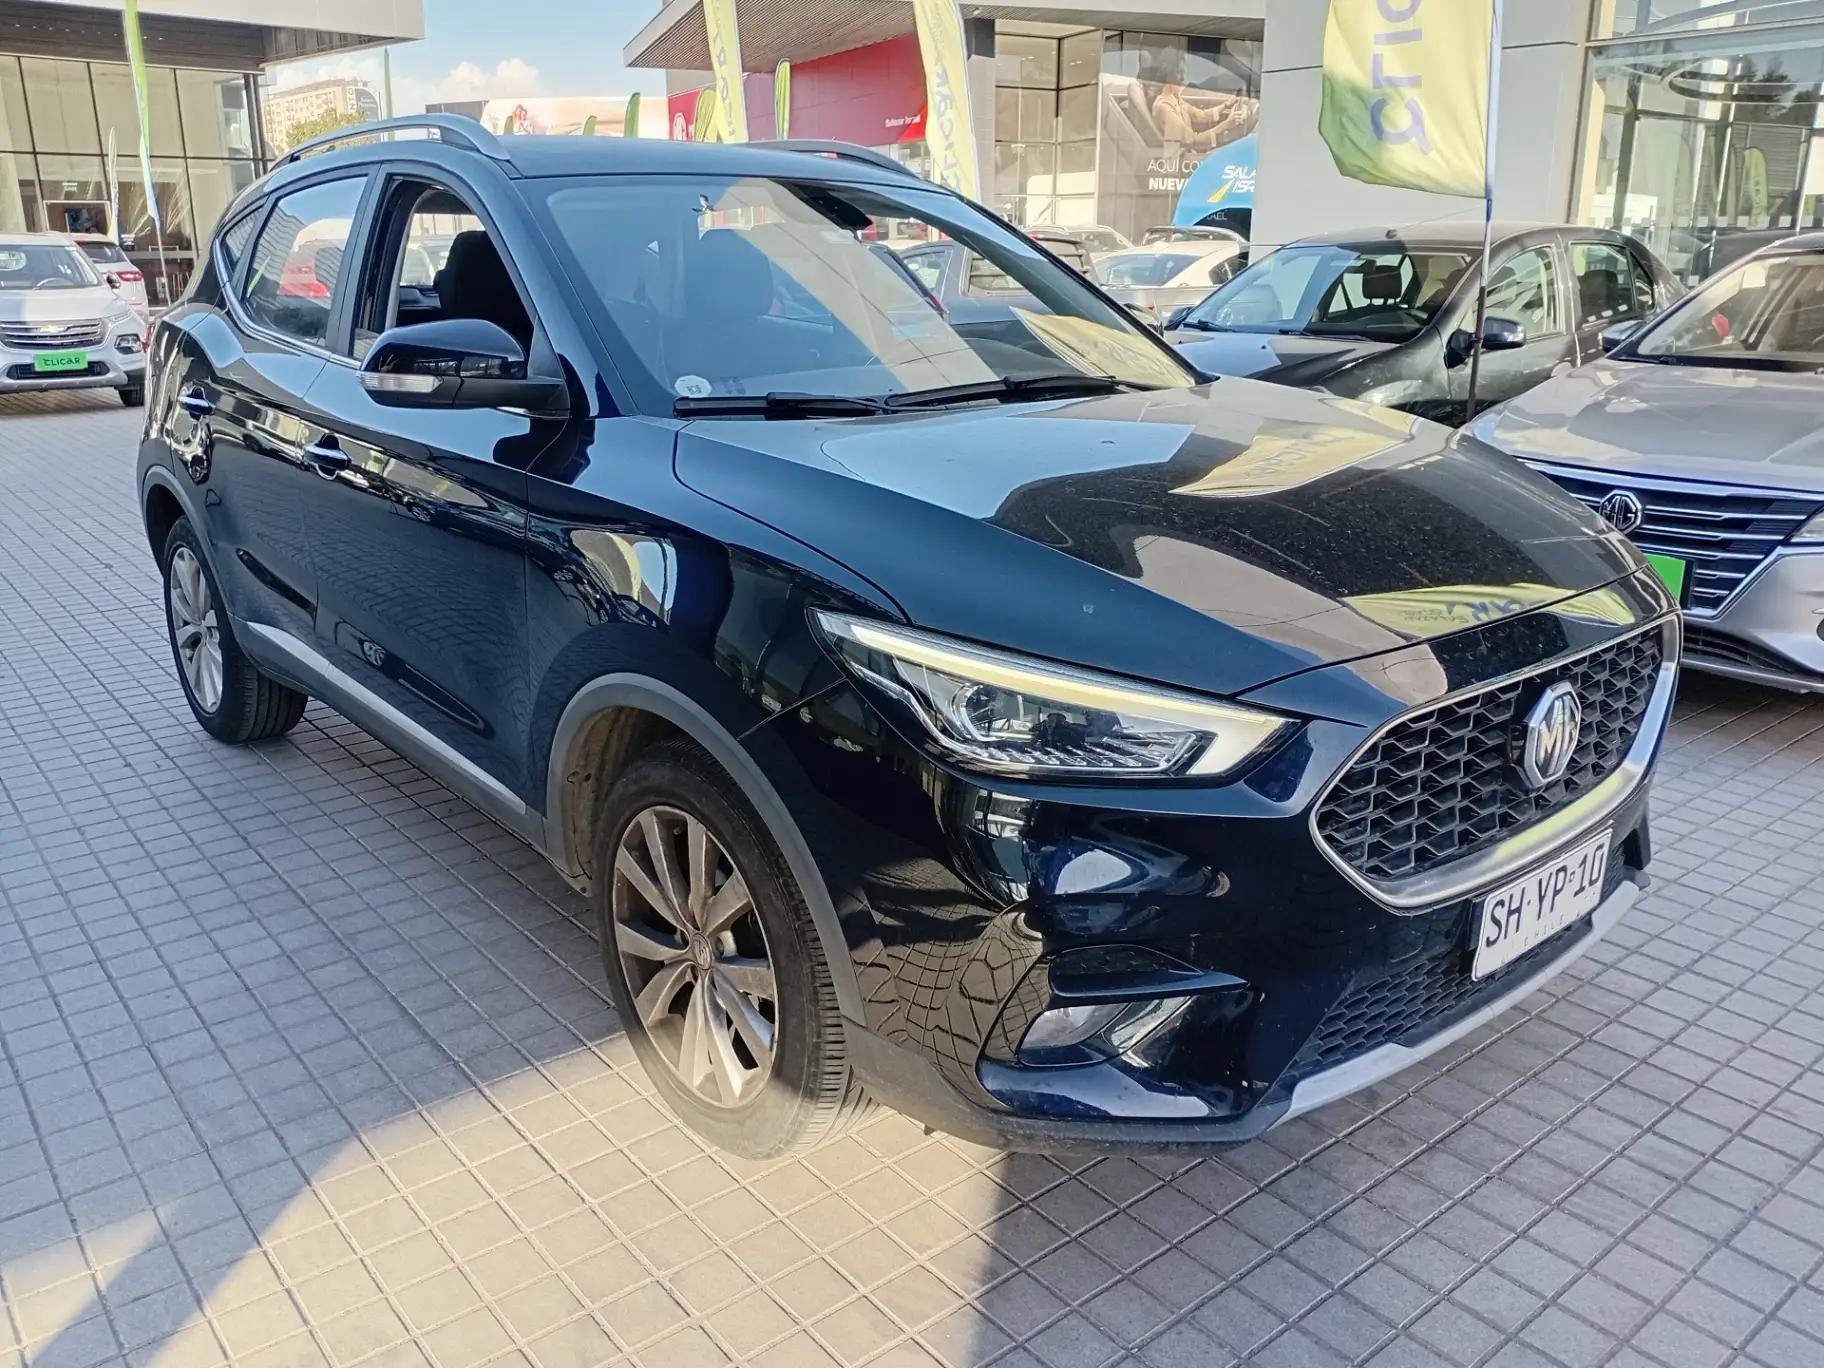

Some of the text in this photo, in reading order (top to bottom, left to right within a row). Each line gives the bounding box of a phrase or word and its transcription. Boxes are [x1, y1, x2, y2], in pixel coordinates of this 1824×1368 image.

[1181, 159, 1201, 174] CO
[1148, 177, 1187, 191] NUEV
[1232, 180, 1256, 193] ISR
[1601, 494, 1638, 531] MG
[1531, 688, 1579, 781] MG
